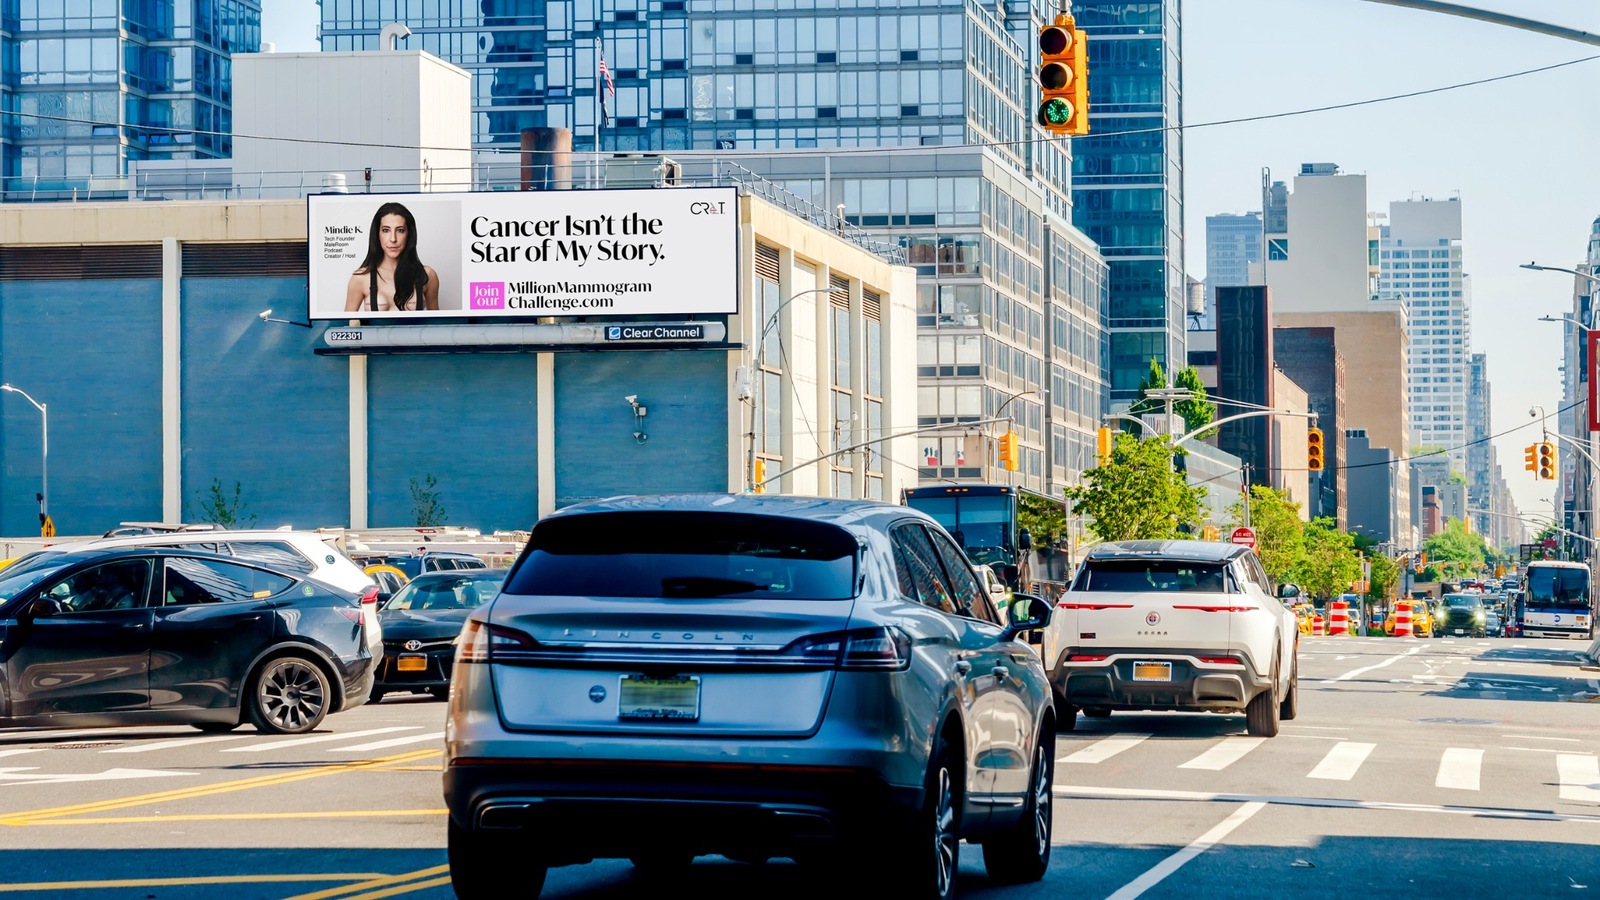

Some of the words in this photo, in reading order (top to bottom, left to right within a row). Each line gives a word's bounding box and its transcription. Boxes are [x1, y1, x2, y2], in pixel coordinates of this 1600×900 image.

[325, 226, 353, 234] Mindie
[355, 226, 363, 234] K.
[471, 216, 560, 237] Cancer
[565, 214, 616, 236] Isn't
[622, 212, 663, 235] the
[471, 241, 520, 263] Star
[525, 239, 553, 262] of
[556, 240, 592, 267] My
[597, 239, 665, 266] Story.
[474, 285, 499, 298] Join
[508, 281, 652, 296] MillionMammogram
[477, 297, 499, 306] our
[508, 296, 613, 312] Challenge.com
[331, 332, 361, 340] 922301
[623, 328, 652, 338] Clear
[654, 327, 699, 338] Channel
[564, 628, 754, 641] LINCOLN
